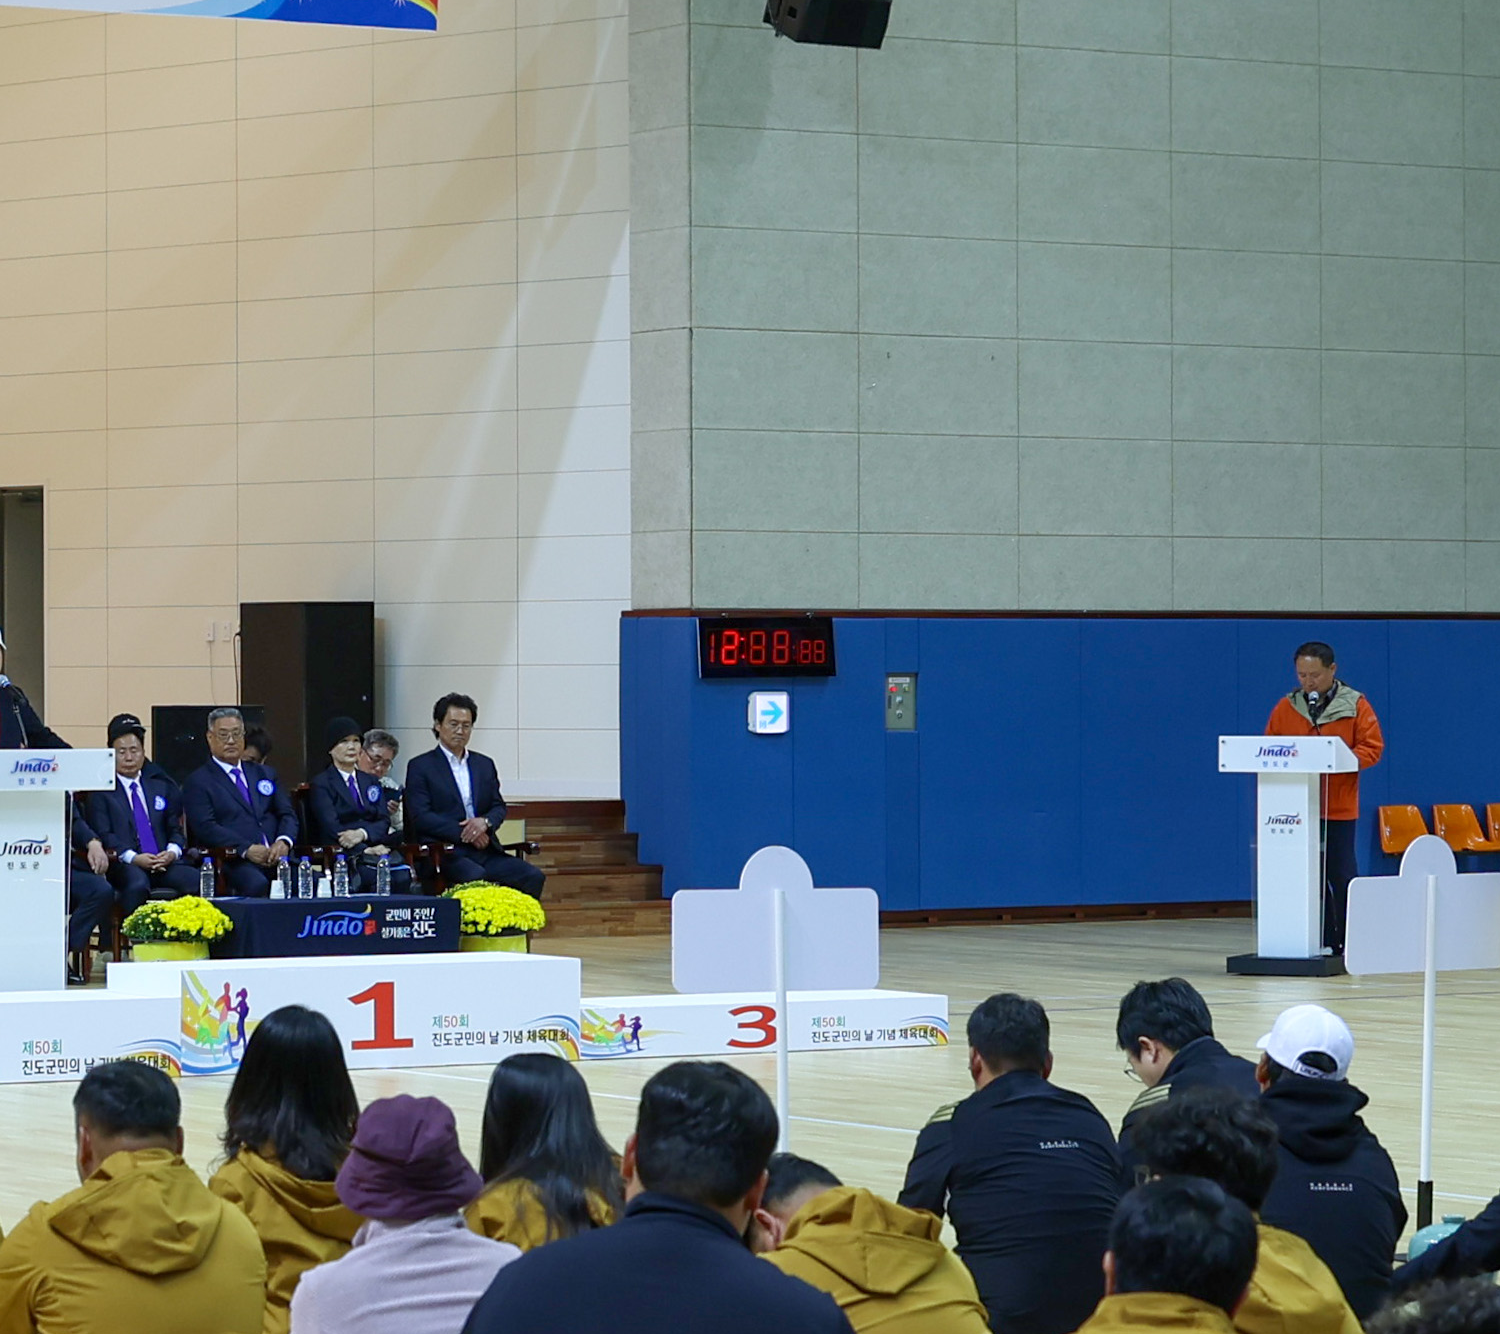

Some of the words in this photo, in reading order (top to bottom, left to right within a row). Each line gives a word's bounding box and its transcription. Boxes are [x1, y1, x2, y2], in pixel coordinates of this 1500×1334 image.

[1255, 746, 1291, 757] Jindo
[10, 760, 51, 774] Jindo
[1265, 816, 1296, 825] Jindo
[385, 908, 411, 921] 군민이
[413, 907, 436, 921] 주인!
[297, 915, 364, 939] Jindo
[411, 920, 437, 939] 진도
[347, 981, 414, 1050] 1
[432, 1013, 469, 1029] 제50회
[811, 1016, 846, 1028] 제50회
[726, 1005, 777, 1049] 3
[811, 1030, 861, 1044] 진도군민의
[864, 1029, 874, 1042] 날
[877, 1028, 896, 1041] 기념
[899, 1026, 939, 1040] 체육대회
[431, 1031, 486, 1047] 진도군민의
[489, 1030, 500, 1044] 날
[503, 1030, 524, 1044] 기념
[526, 1027, 571, 1043] 체육대회
[22, 1039, 63, 1056] 제50회
[21, 1058, 80, 1076] 진도군민의
